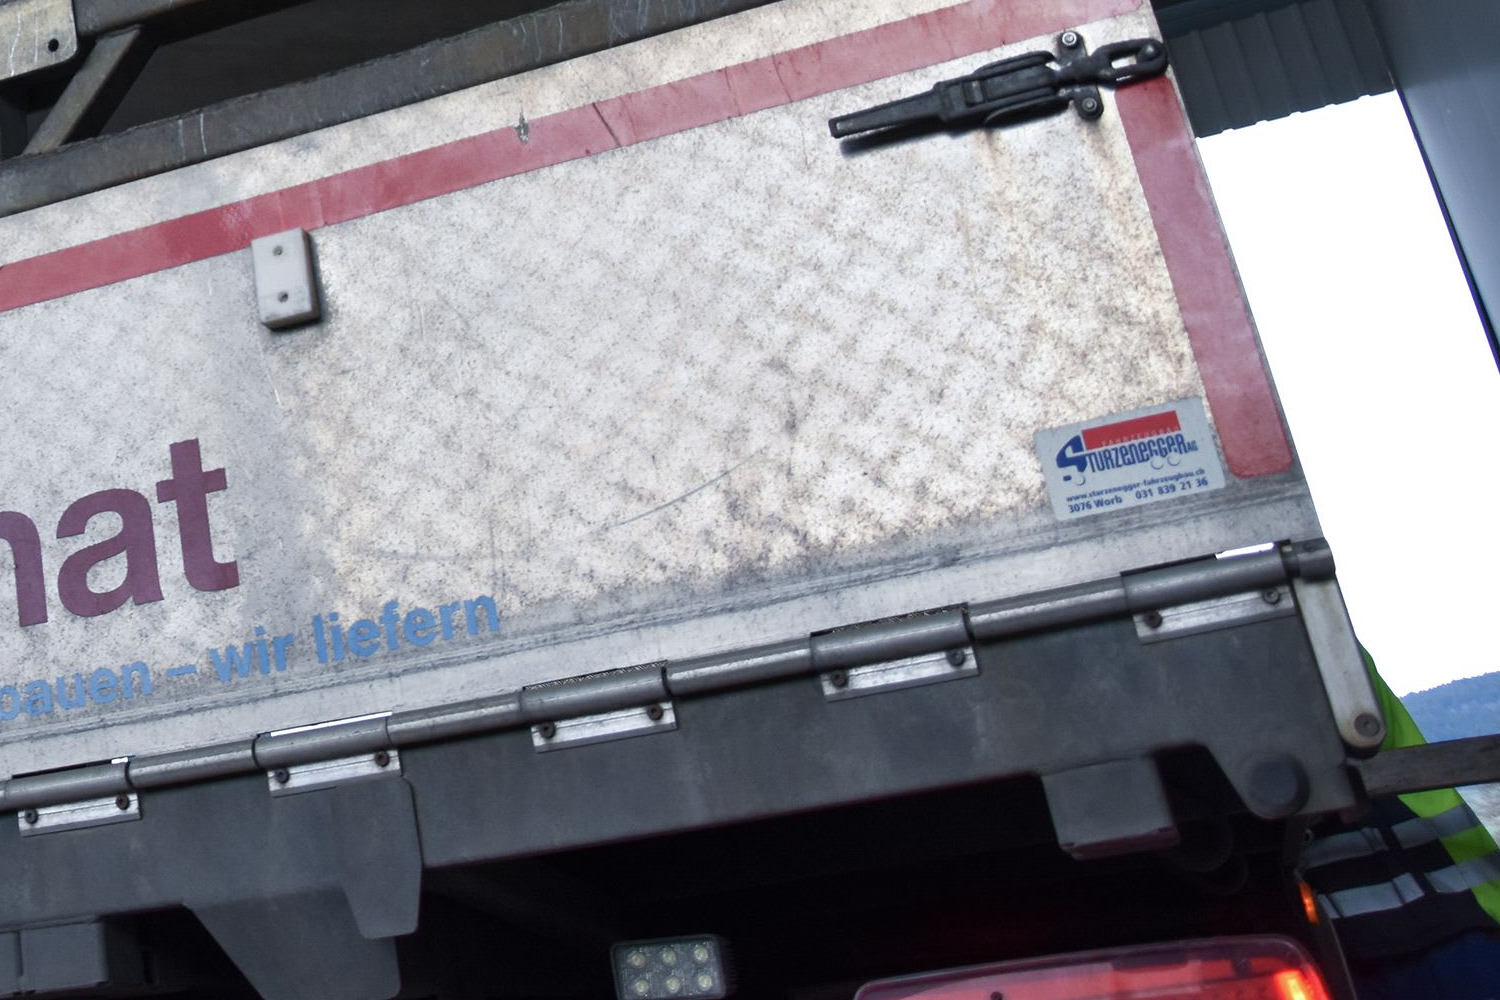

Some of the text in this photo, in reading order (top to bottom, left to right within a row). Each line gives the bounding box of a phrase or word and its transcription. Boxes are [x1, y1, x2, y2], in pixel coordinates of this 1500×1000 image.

[1187, 440, 1198, 455] AG
[1068, 477, 1209, 514] 3076 Worb 031 839 21 36
[209, 626, 294, 681] wir
[313, 595, 500, 664] liefern
